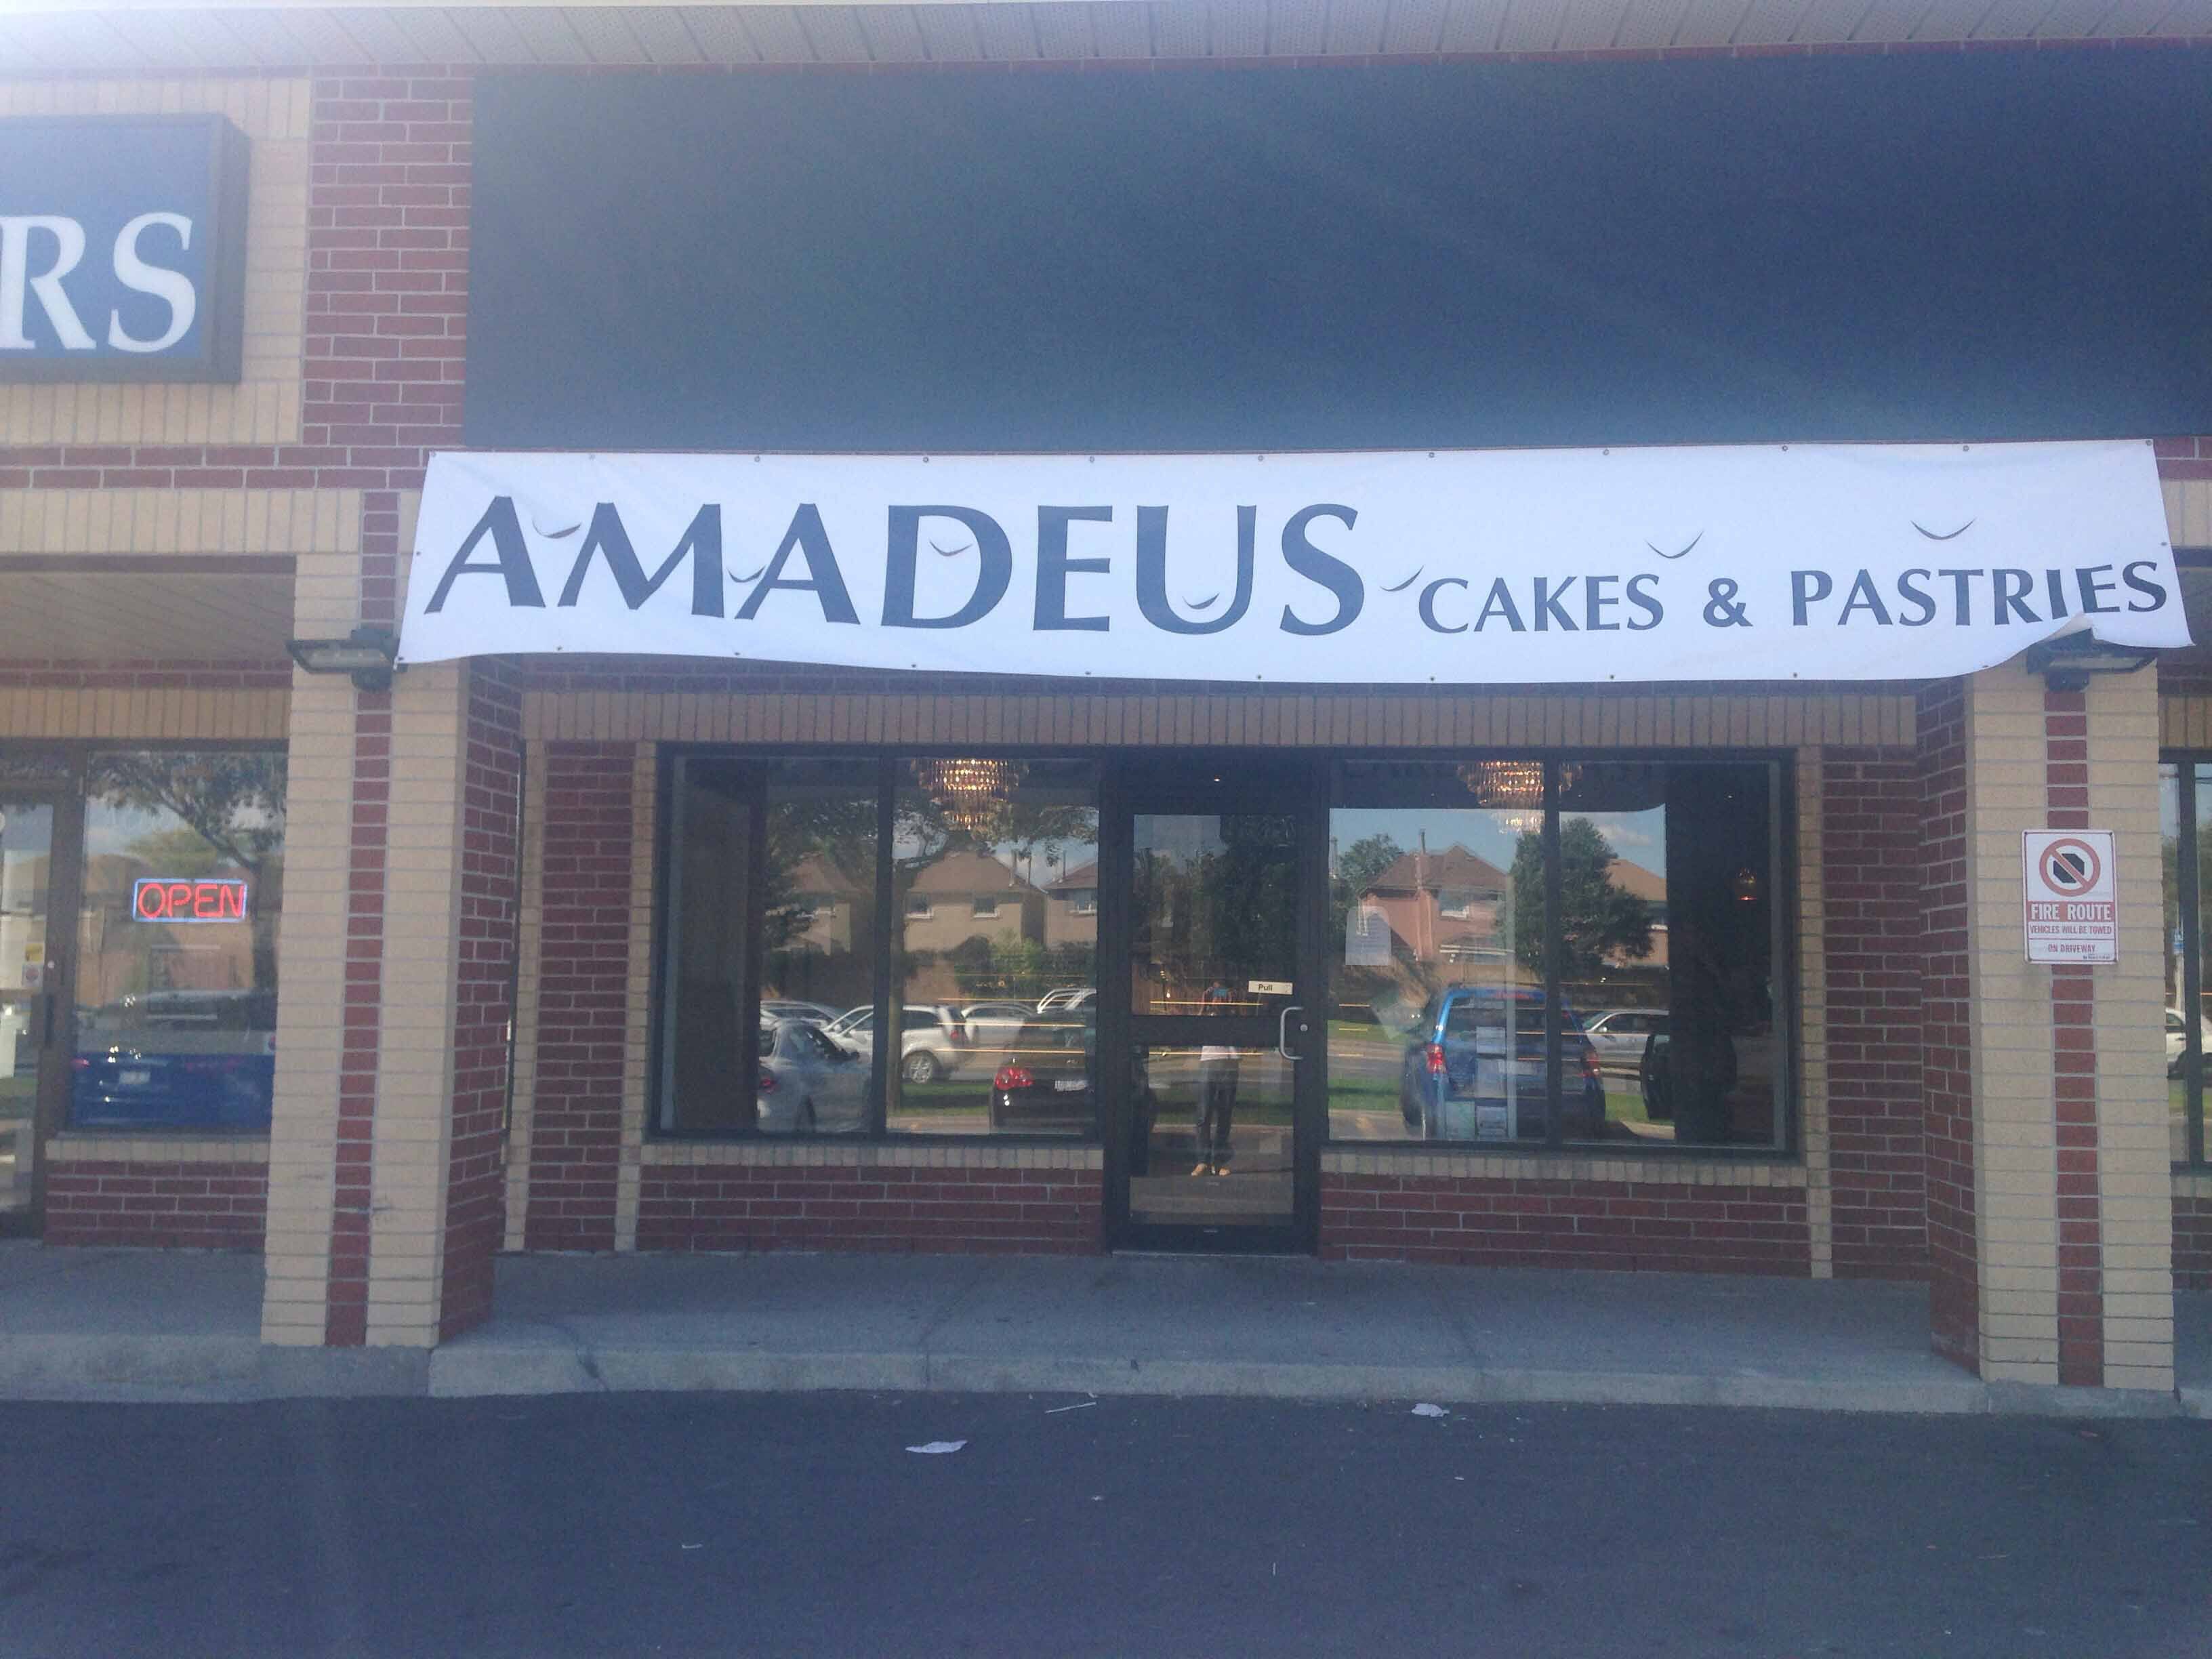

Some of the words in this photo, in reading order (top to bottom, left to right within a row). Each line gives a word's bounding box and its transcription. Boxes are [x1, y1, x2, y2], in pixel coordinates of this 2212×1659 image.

[0, 212, 196, 353] RS
[424, 495, 1365, 636] AMADEUS
[1418, 573, 1664, 634] CAKES
[1702, 577, 1754, 628] &
[1790, 561, 2167, 627] PASTRIES
[138, 882, 245, 919] OPEN
[2030, 903, 2060, 920] FIRE
[2067, 904, 2112, 921] ROUTE
[2030, 925, 2060, 934] VEHICLES
[2062, 926, 2077, 934] WILL
[2078, 926, 2088, 934] BE
[2089, 926, 2112, 935] TOWED
[2060, 944, 2095, 953] DRIVEWAY
[1258, 983, 1273, 991] Pull
